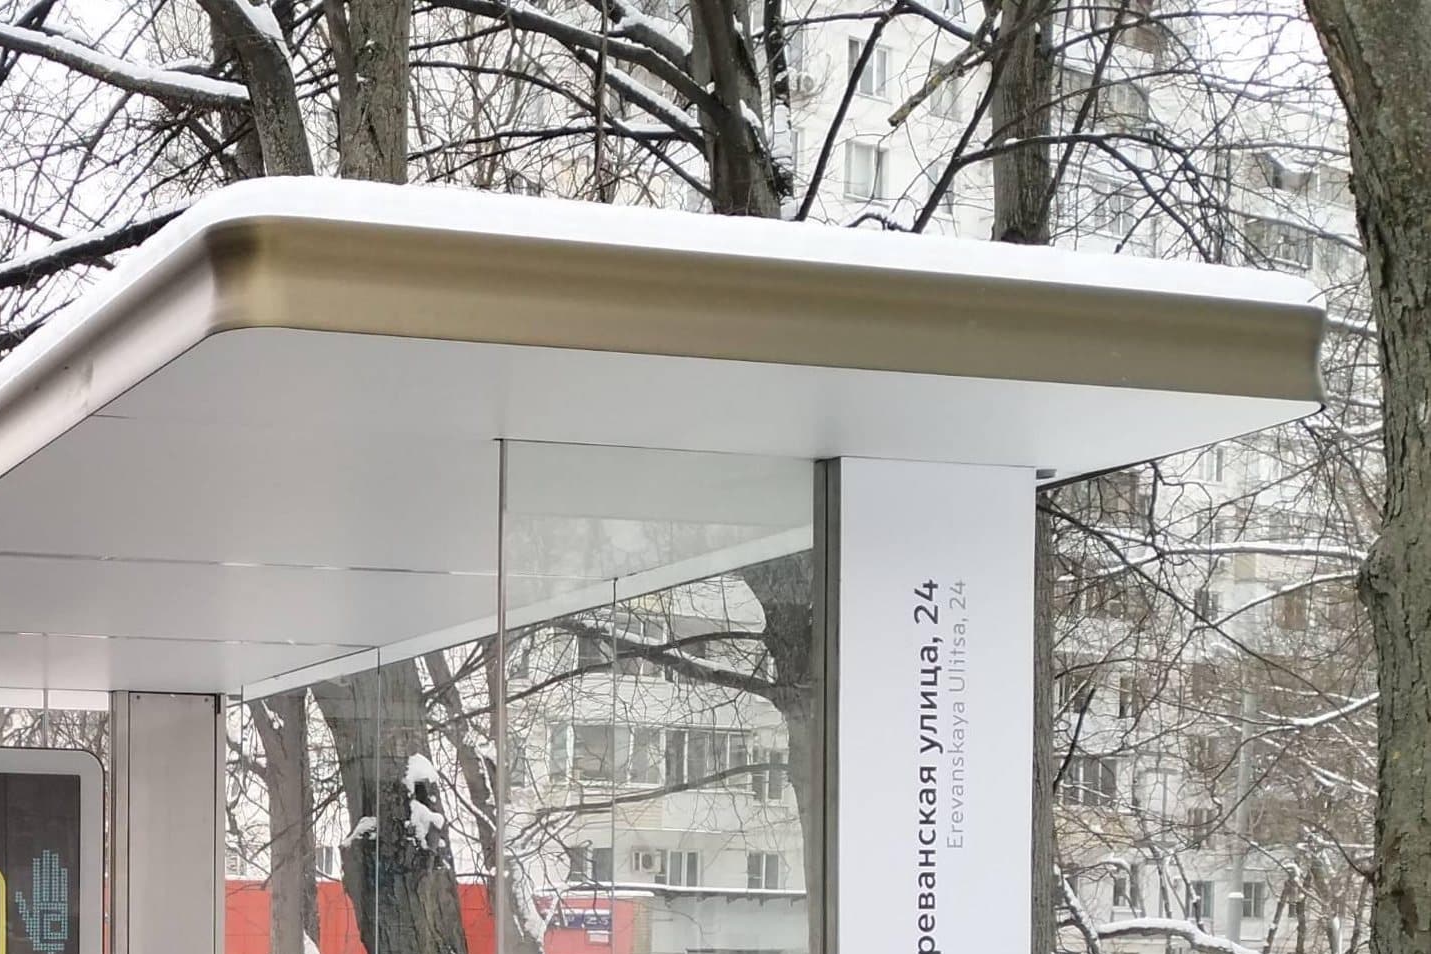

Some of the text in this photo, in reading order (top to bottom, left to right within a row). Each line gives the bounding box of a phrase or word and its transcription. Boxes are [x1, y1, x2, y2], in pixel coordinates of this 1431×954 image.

[913, 579, 939, 625] 24
[919, 635, 944, 755] улица,
[946, 579, 969, 849] Erevanskaya Ulitsa, 24
